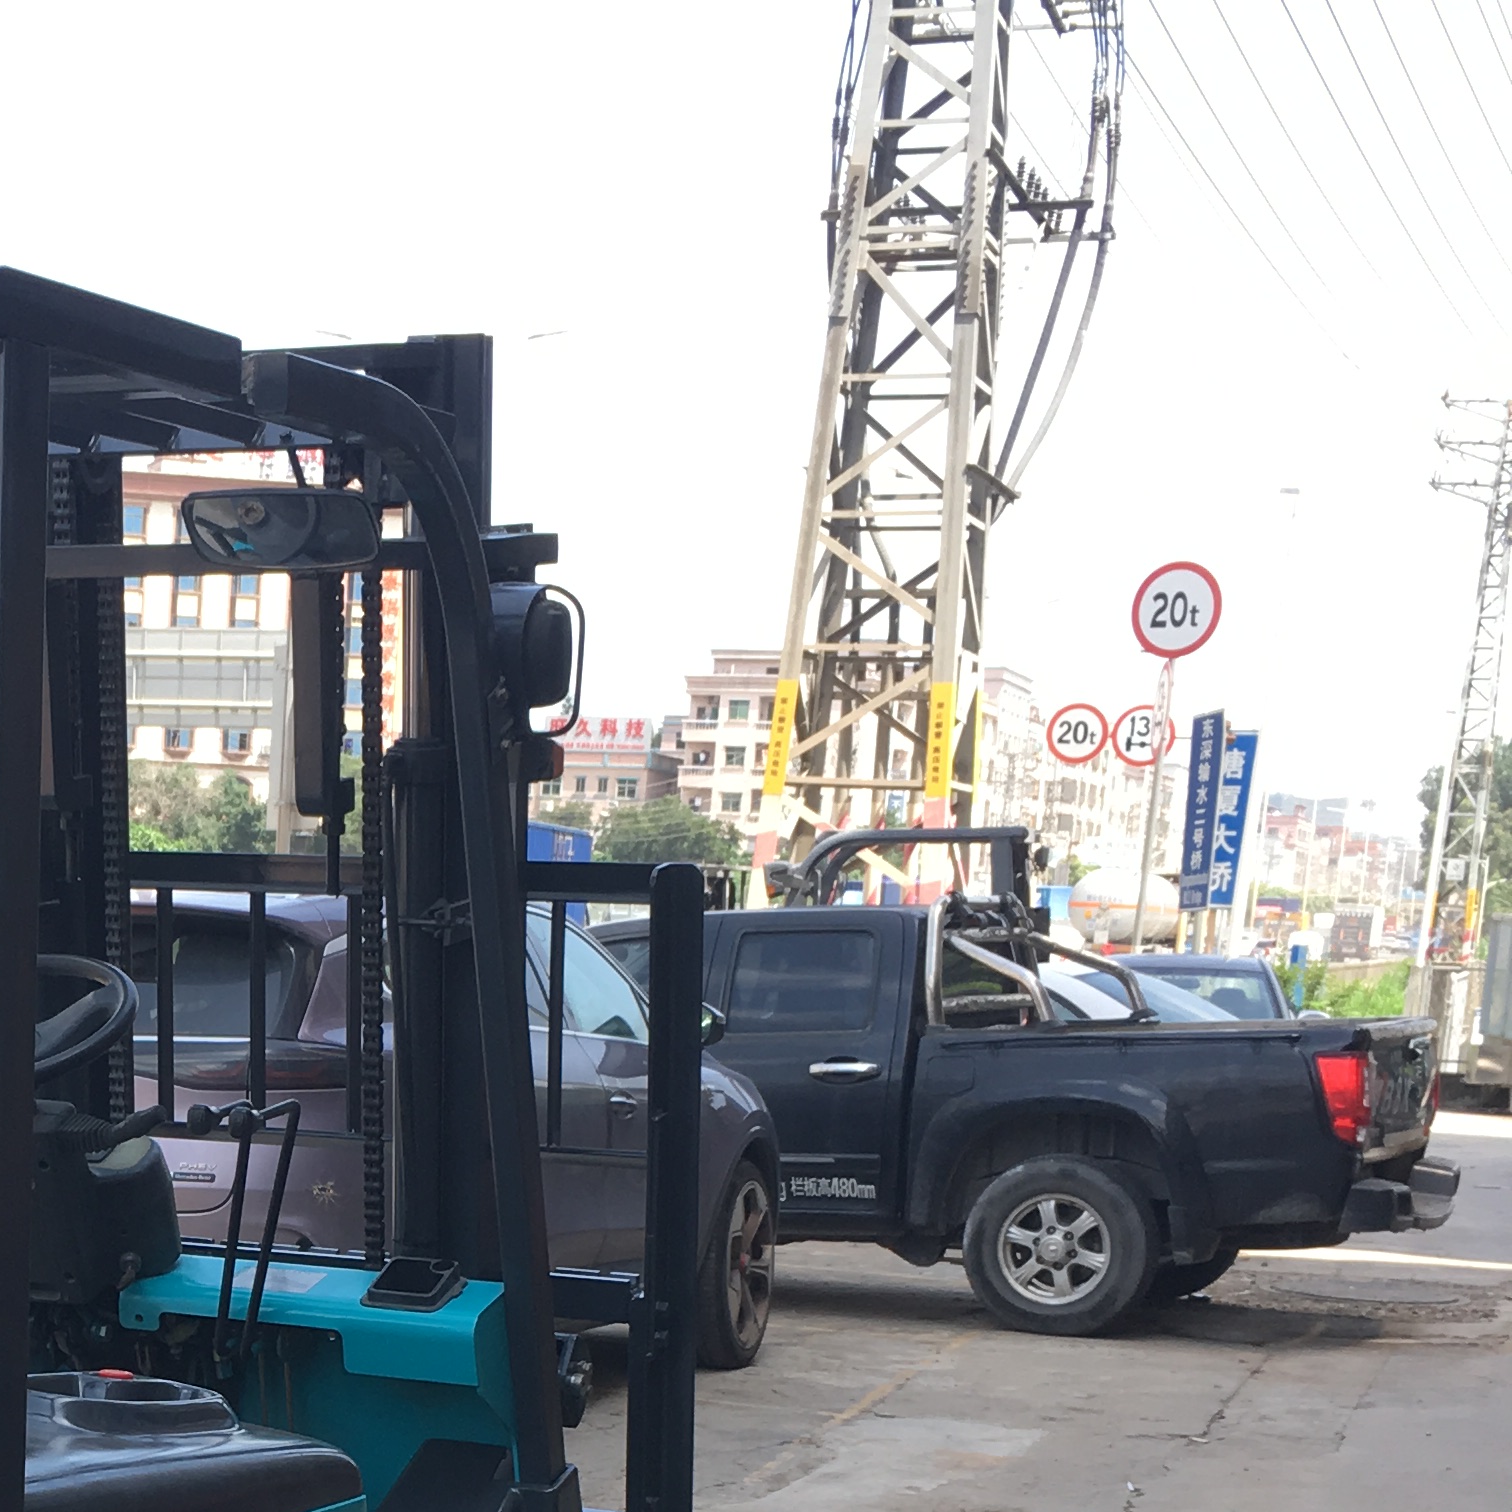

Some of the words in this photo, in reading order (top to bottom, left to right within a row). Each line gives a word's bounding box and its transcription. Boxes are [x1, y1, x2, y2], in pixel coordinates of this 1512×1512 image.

[1150, 591, 1200, 628] 20t
[1057, 720, 1097, 744] 20t
[1190, 718, 1215, 871] 东深输水二号桥
